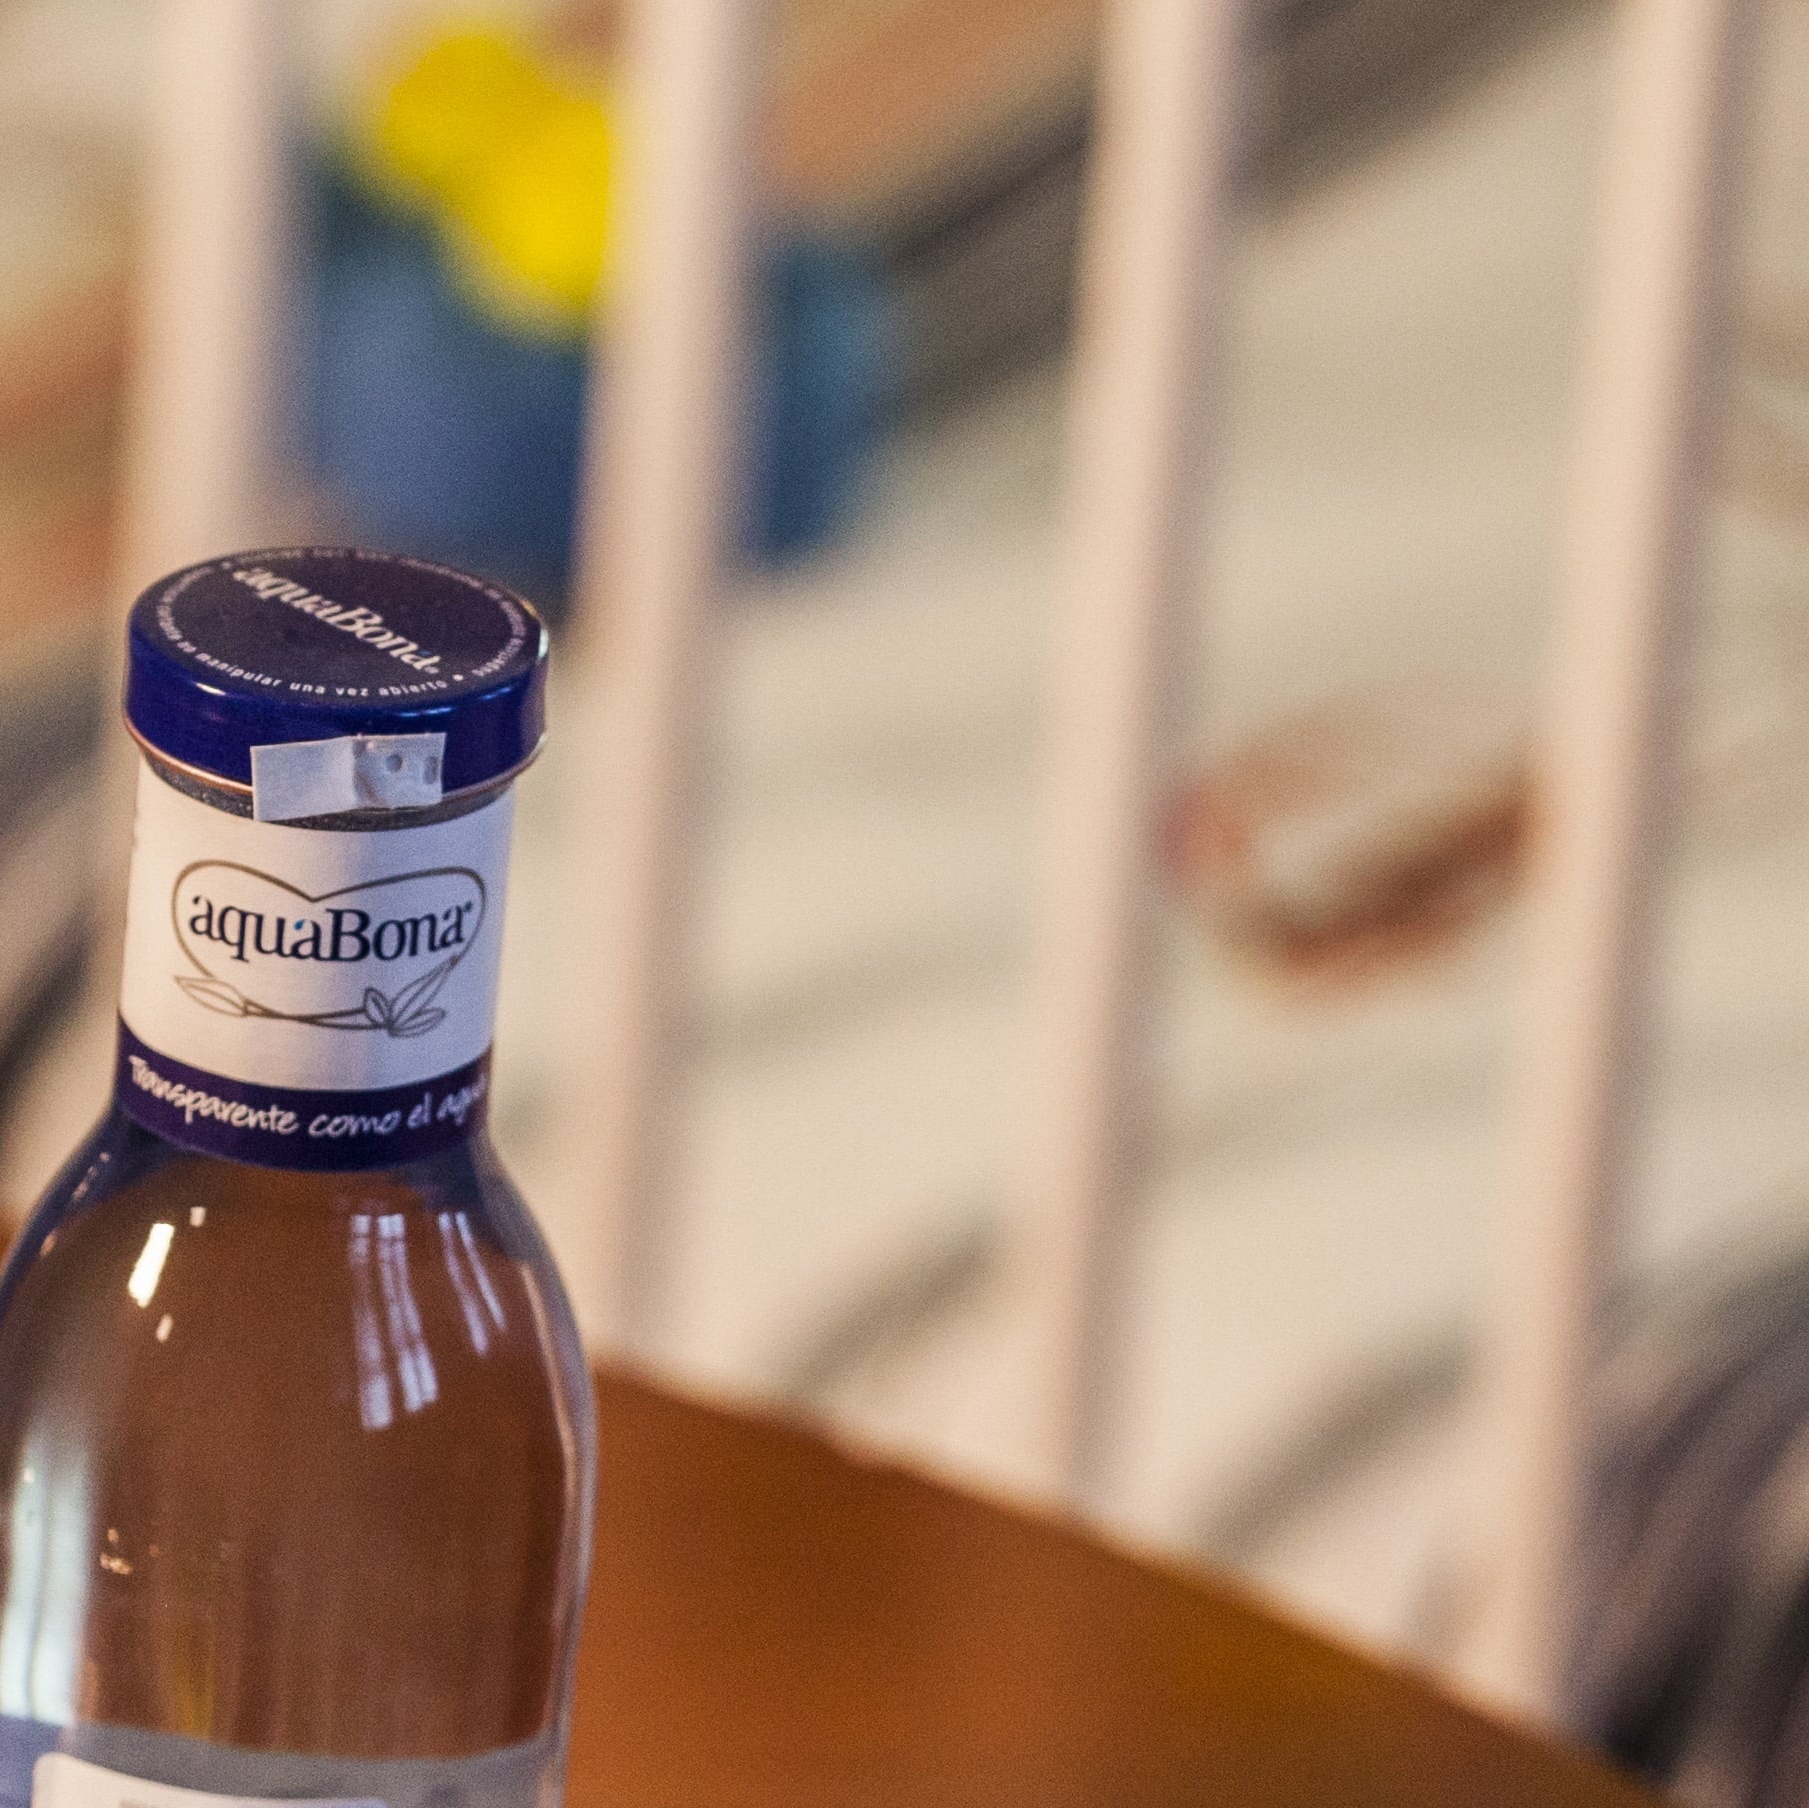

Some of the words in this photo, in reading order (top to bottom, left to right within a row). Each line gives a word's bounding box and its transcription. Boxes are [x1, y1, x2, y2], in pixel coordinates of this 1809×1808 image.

[233, 566, 442, 672] aquaBona
[289, 681, 326, 696] una
[335, 686, 370, 698] vez
[379, 679, 449, 698] abierto
[188, 895, 467, 964] aquaBona
[127, 1052, 301, 1136] Transparente
[307, 1106, 401, 1138] como
[407, 1090, 433, 1130] el
